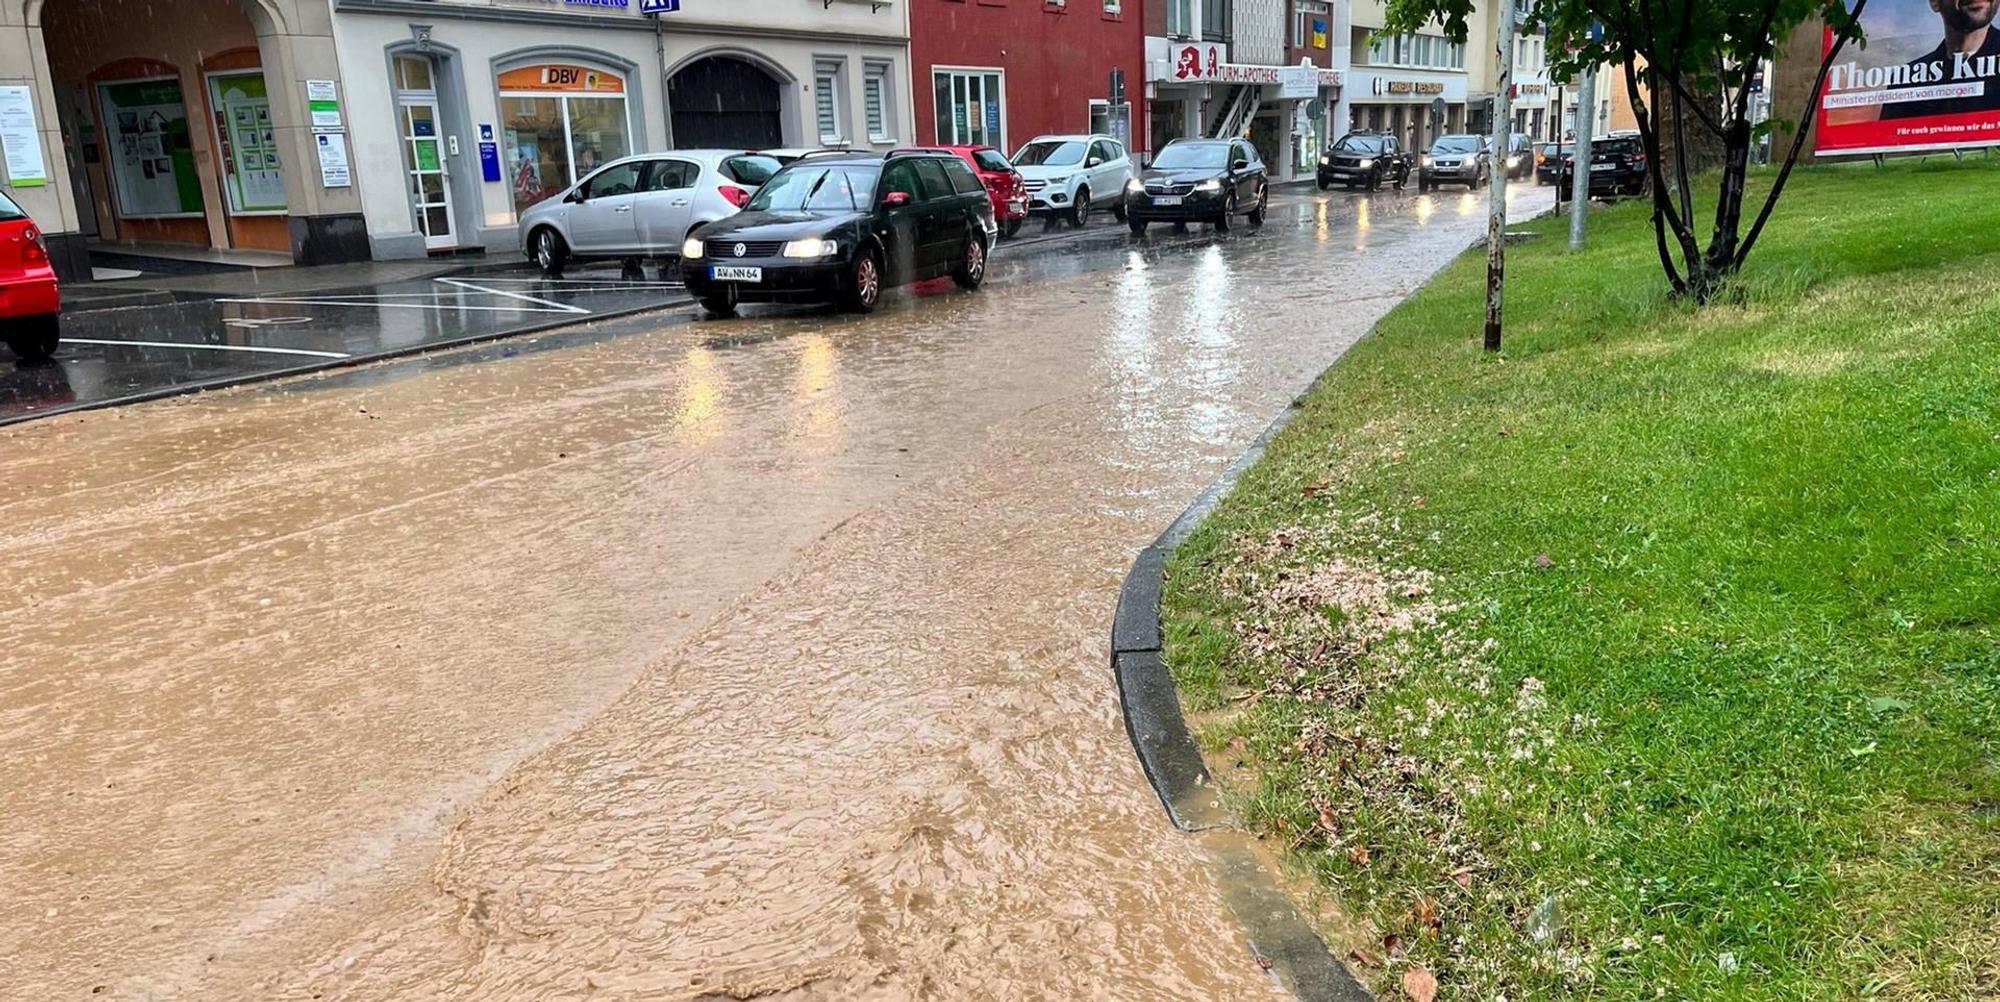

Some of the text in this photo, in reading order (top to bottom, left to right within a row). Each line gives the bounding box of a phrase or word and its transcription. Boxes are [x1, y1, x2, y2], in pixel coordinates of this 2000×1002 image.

[549, 69, 579, 84] DBV
[1219, 66, 1278, 82] TURM-APOTHEKE
[1828, 61, 1943, 91] Thomas
[1830, 91, 1912, 105] Ministerpräsident
[1916, 90, 1934, 98] von
[1897, 127, 1910, 136] Für
[1929, 124, 1965, 134] gewinnen
[1966, 123, 1980, 131] wir
[1981, 121, 1995, 130] das
[746, 268, 758, 279] 64
